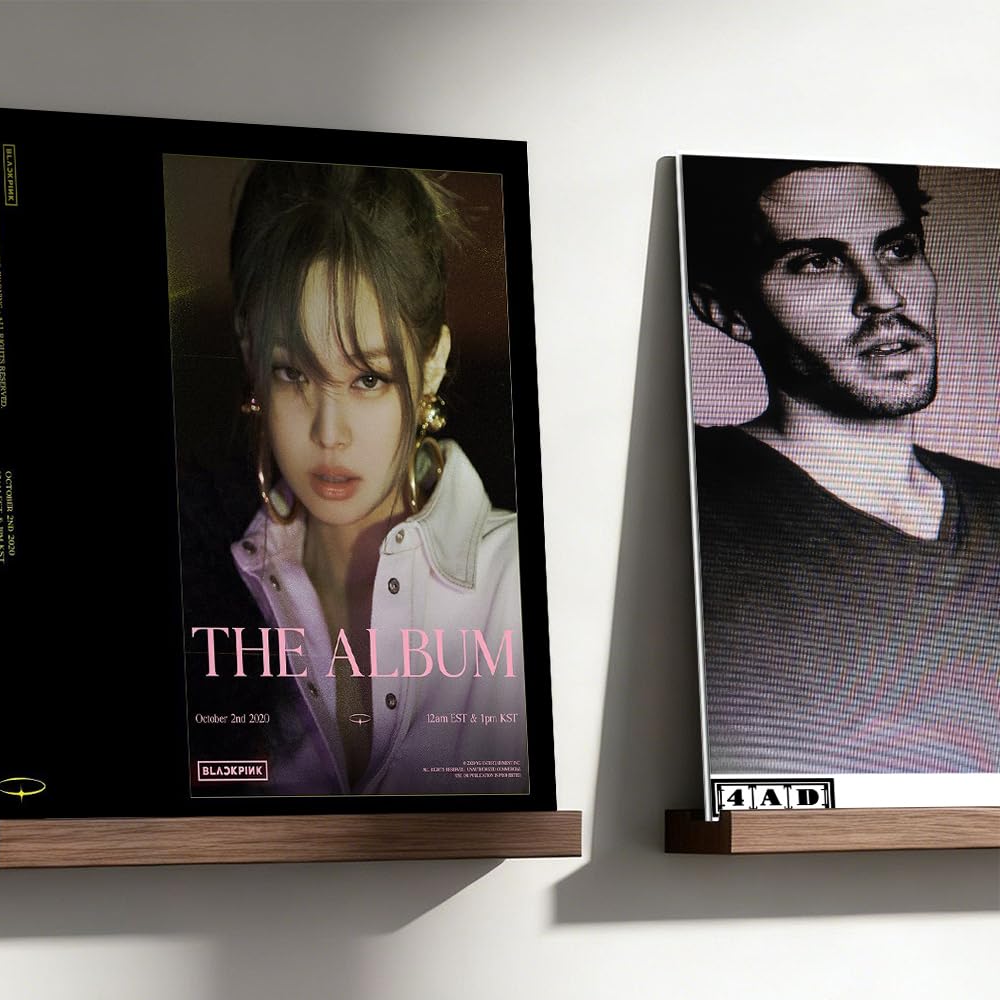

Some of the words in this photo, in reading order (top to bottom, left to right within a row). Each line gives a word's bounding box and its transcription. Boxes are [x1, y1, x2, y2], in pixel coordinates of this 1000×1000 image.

[191, 627, 308, 678] THE
[325, 628, 517, 678] ALBUM
[195, 713, 228, 724] October
[231, 713, 246, 724] 2nd
[249, 713, 270, 724] 2020
[427, 713, 448, 723] 12am
[450, 713, 467, 723] EST
[470, 714, 478, 723] &
[481, 714, 497, 726] 1pm
[500, 713, 518, 723] KST
[202, 766, 263, 776] BLACKPINK
[726, 788, 820, 806] 4AD
